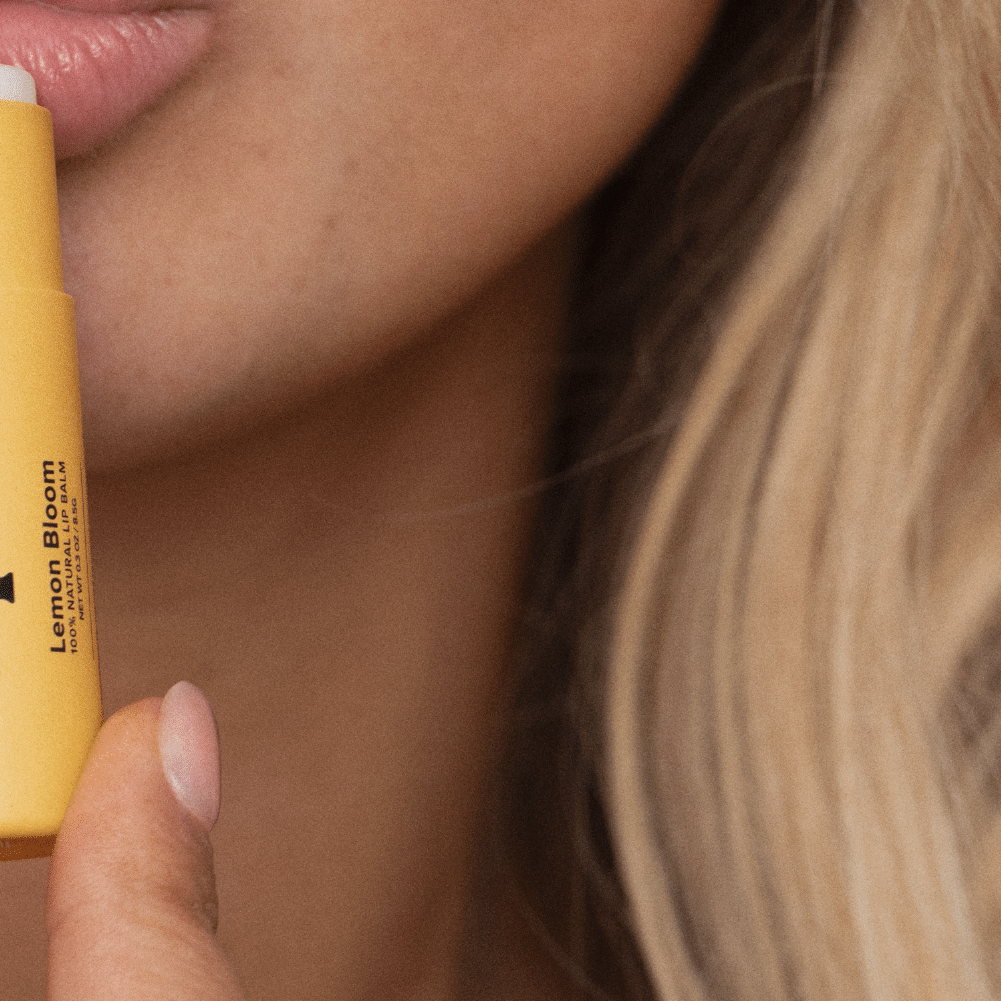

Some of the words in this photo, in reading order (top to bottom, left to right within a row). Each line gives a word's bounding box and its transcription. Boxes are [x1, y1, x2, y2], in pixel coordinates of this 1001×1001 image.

[58, 461, 68, 504] BALM
[42, 460, 60, 549] Bloom
[61, 509, 70, 532] LIP
[73, 535, 80, 552] OZ
[63, 538, 75, 611] NATURAL
[76, 575, 83, 594] WT
[49, 560, 66, 653] Lemon
[68, 616, 78, 655] 100%
